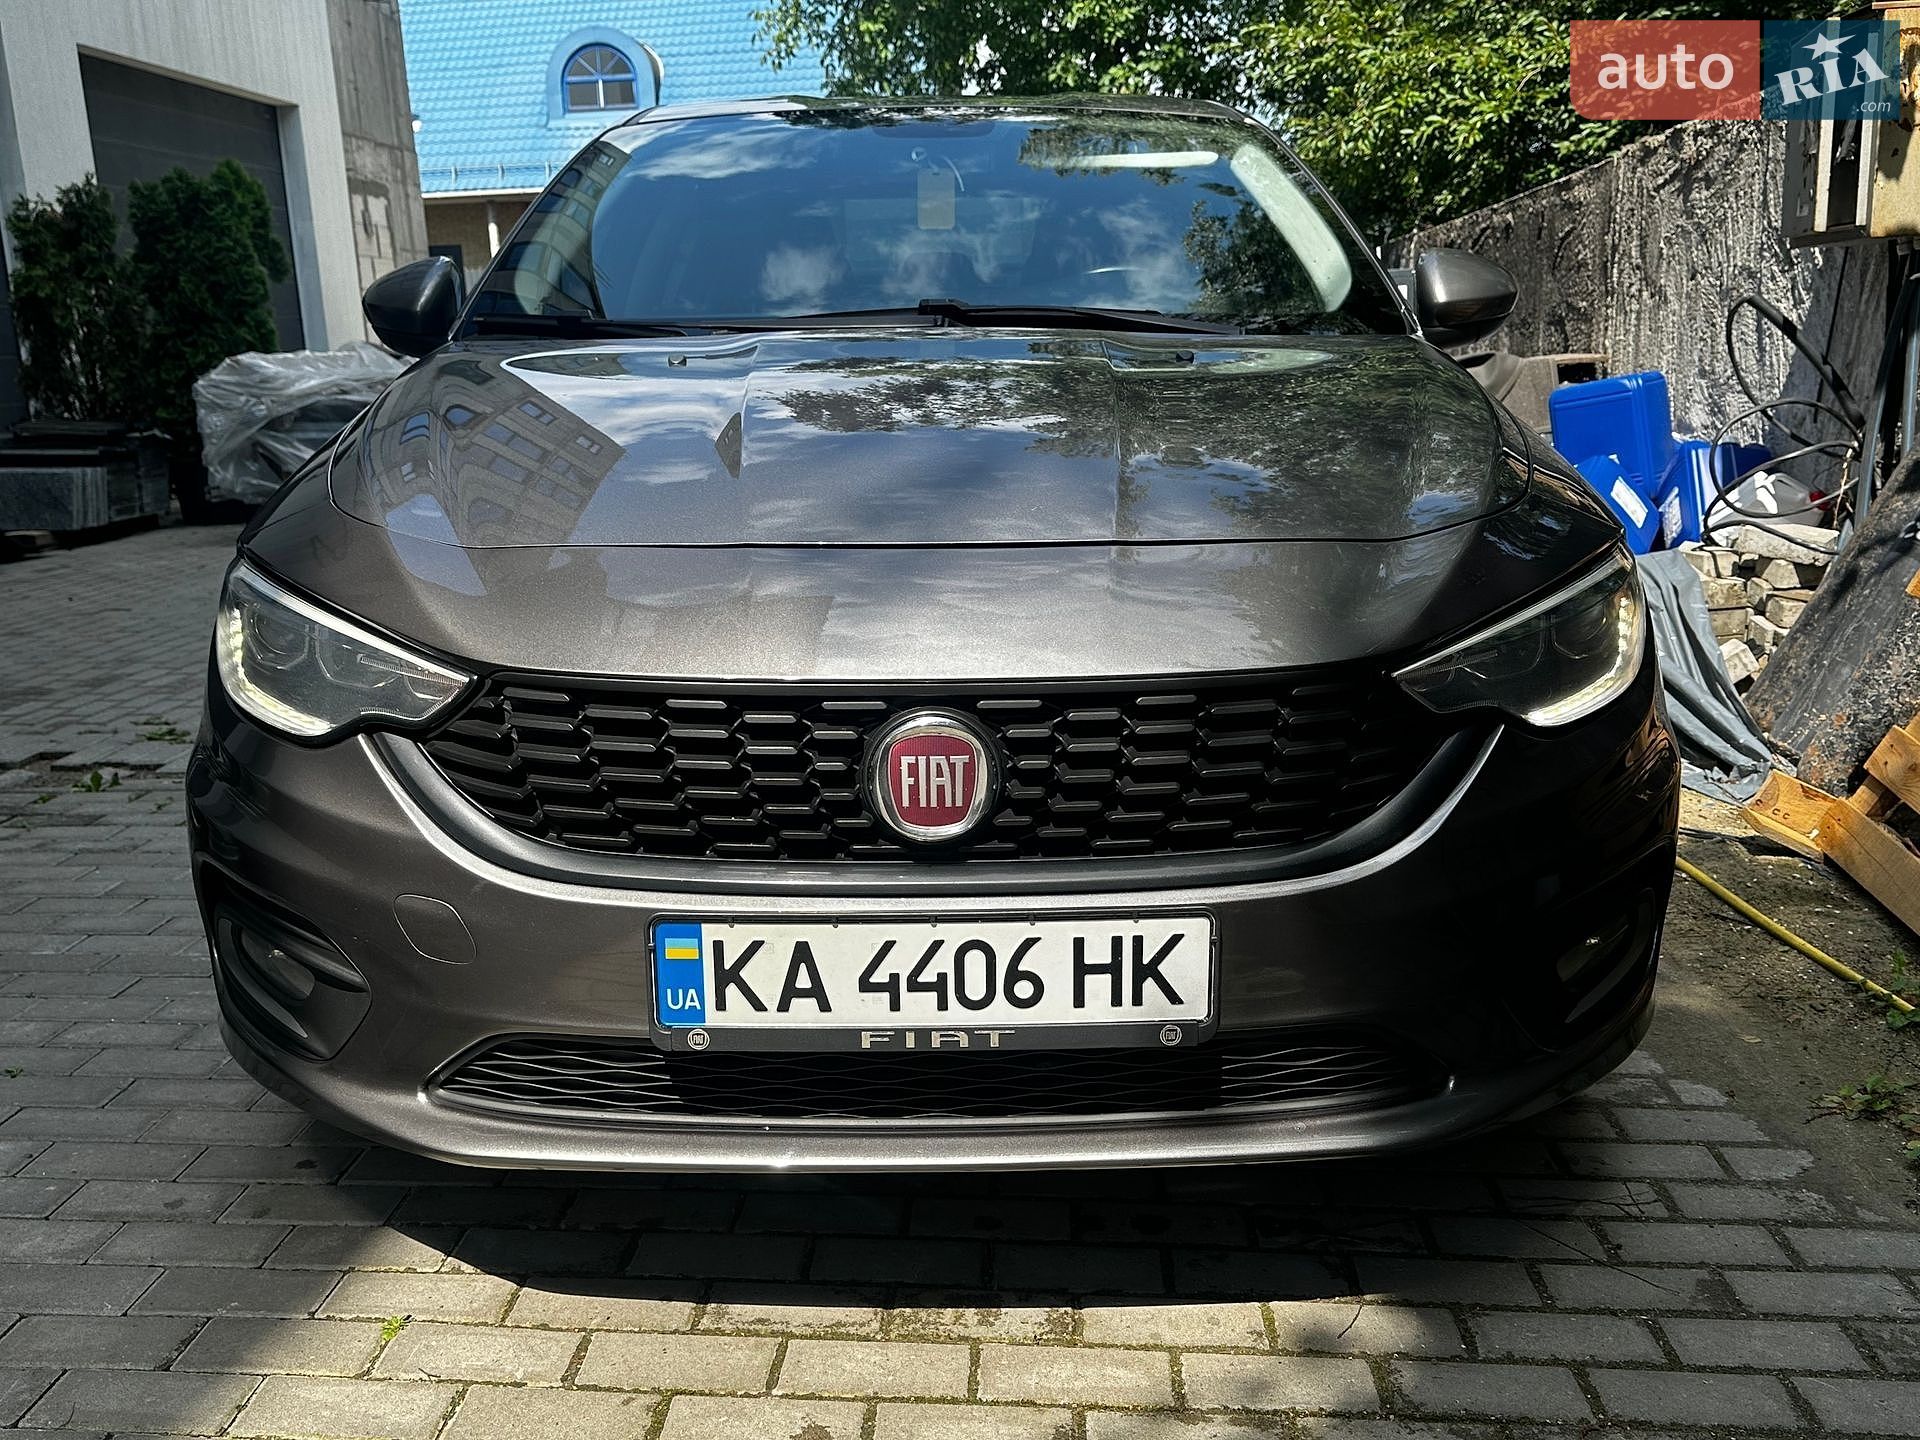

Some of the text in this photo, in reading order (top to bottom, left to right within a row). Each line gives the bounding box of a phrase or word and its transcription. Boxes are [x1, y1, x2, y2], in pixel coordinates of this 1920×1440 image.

[901, 755, 970, 808] FIAT
[712, 933, 1187, 1013] KA 4406 HK
[666, 988, 702, 1011] UA
[861, 1029, 1015, 1050] FIAT
